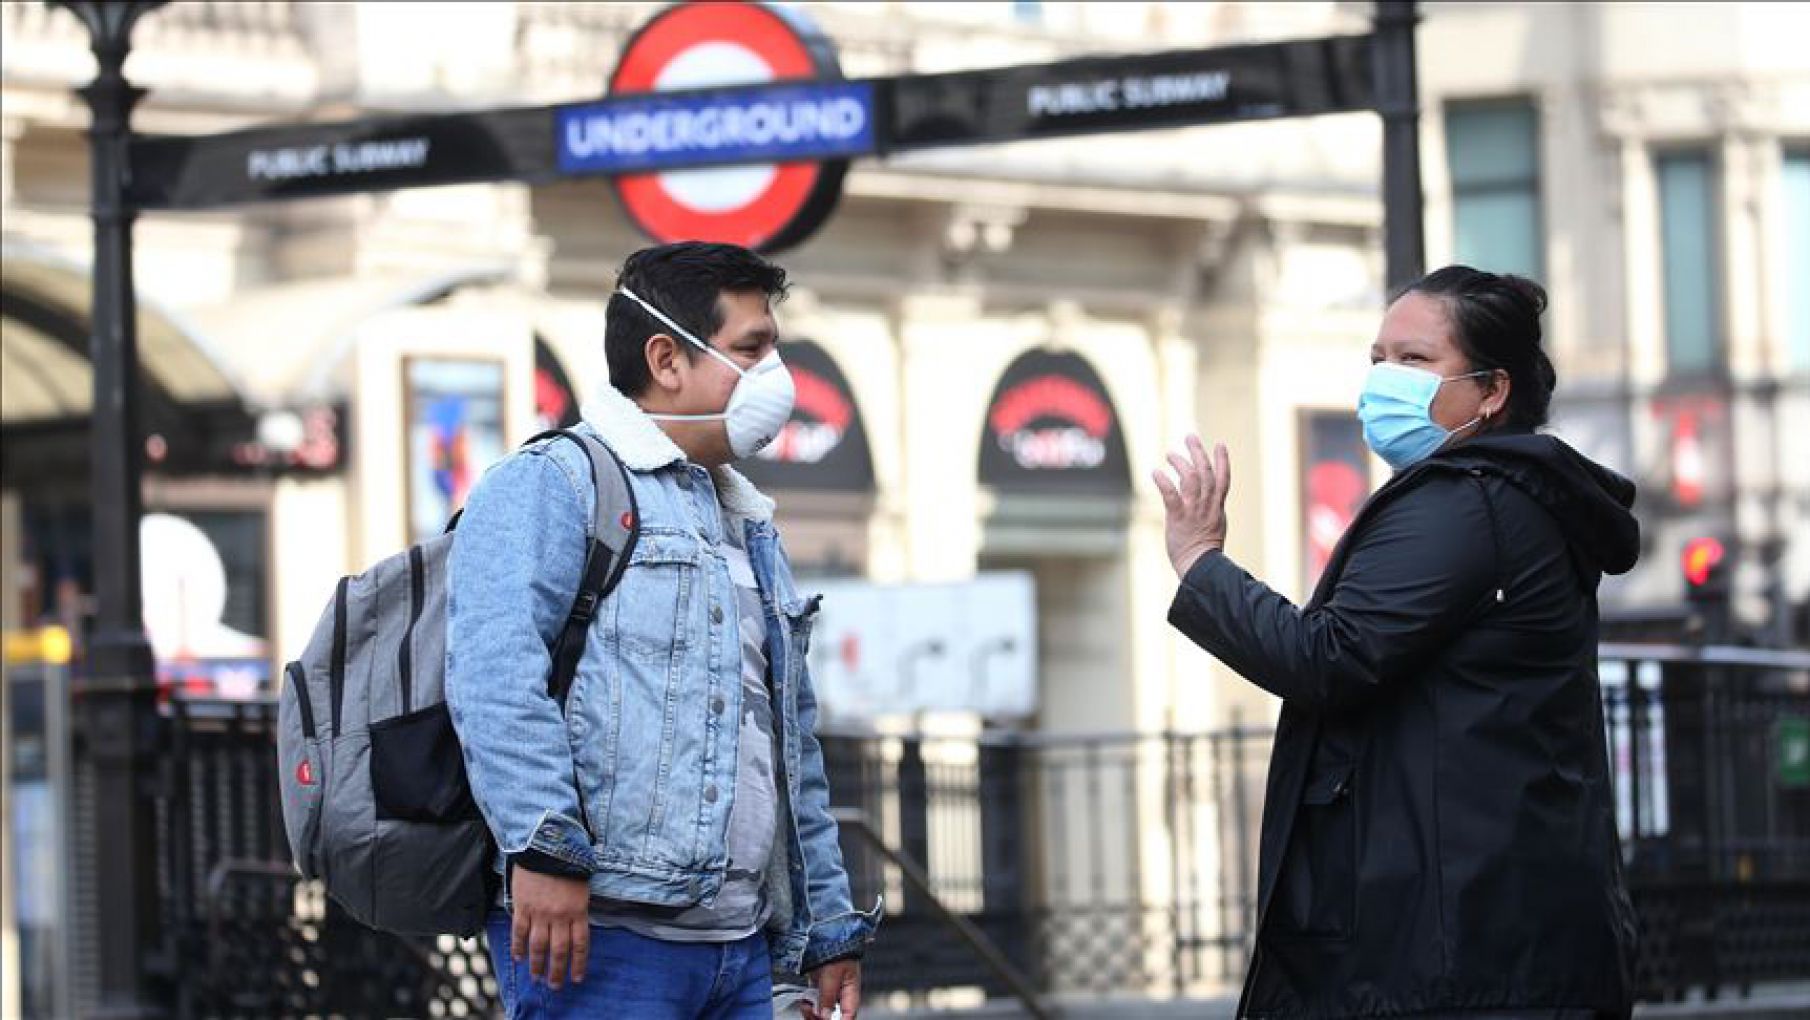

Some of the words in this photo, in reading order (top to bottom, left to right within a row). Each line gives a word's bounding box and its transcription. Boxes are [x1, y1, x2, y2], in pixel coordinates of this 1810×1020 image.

[1028, 82, 1118, 116] PUBLIC
[1121, 71, 1230, 107] SUBWAY
[566, 97, 866, 158] UNDERGROUND
[248, 147, 329, 178] PUBLIC
[334, 137, 430, 172] SUBWAY
